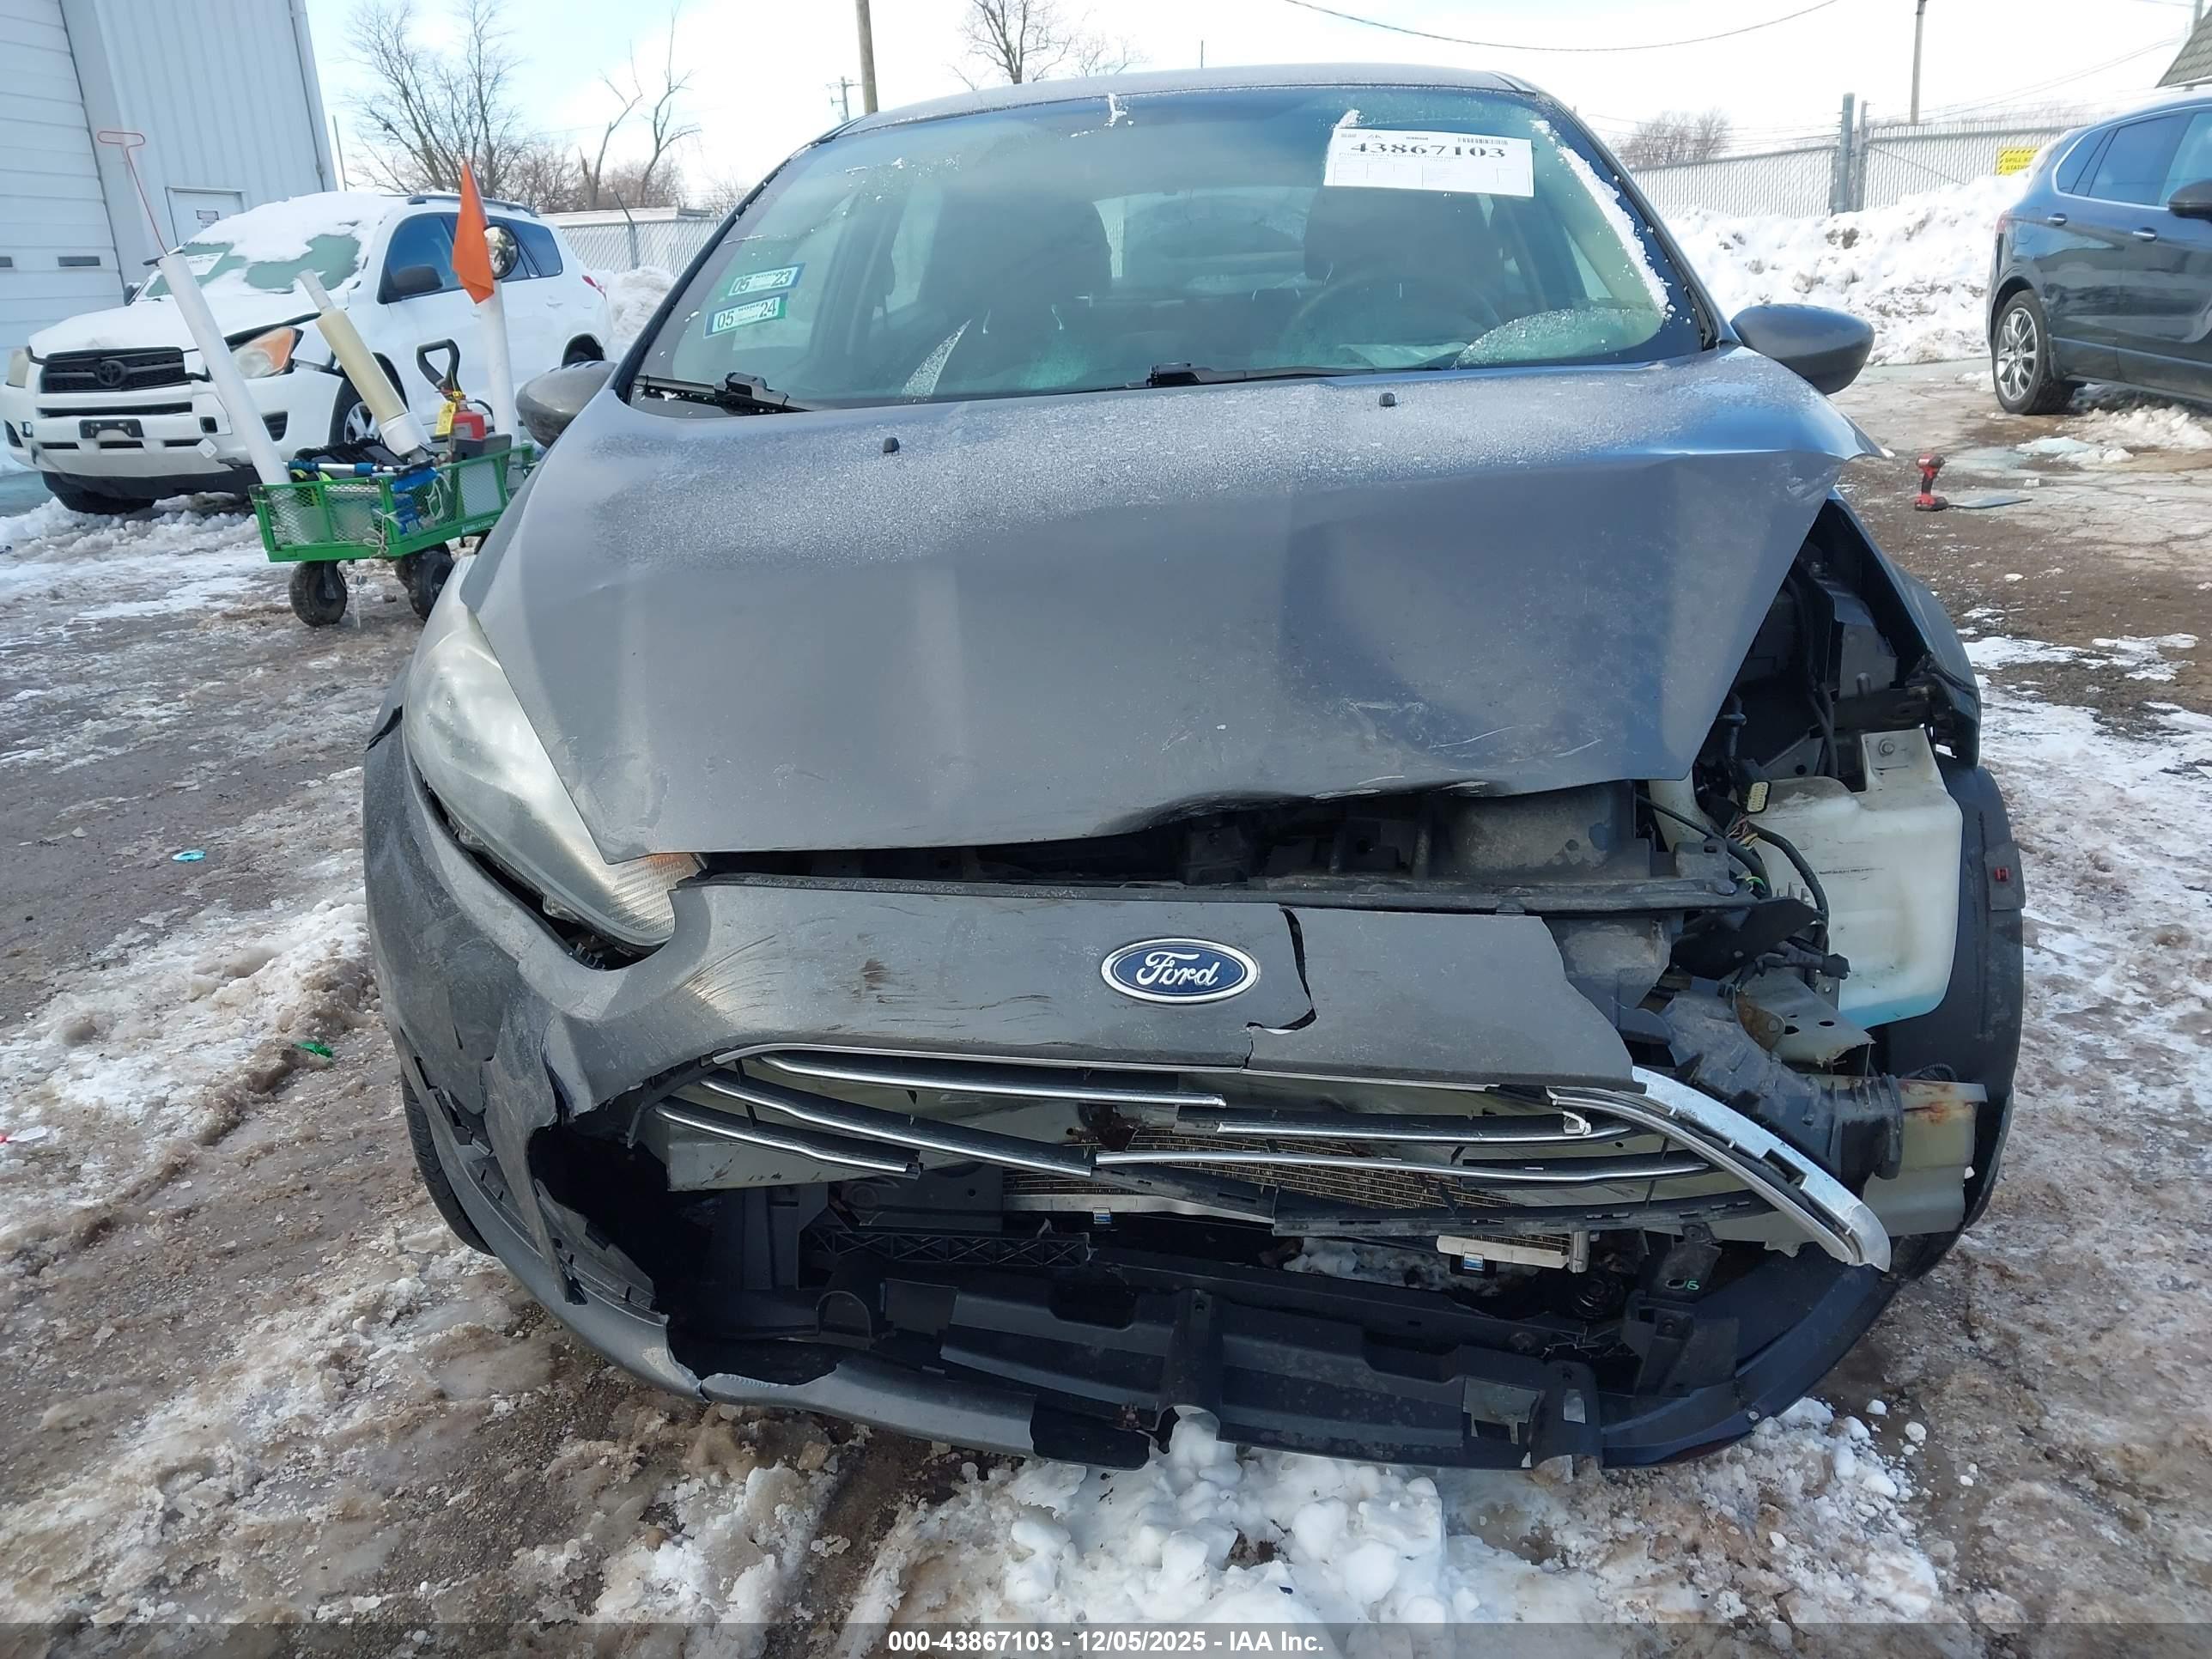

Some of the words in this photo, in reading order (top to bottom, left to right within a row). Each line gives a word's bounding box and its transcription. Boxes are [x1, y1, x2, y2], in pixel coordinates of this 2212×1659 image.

[1351, 143, 1505, 159] 43867103
[732, 276, 752, 294] 05
[770, 270, 793, 288] 23
[717, 310, 734, 329] 05
[759, 299, 776, 318] 24
[1136, 951, 1220, 986] Ford
